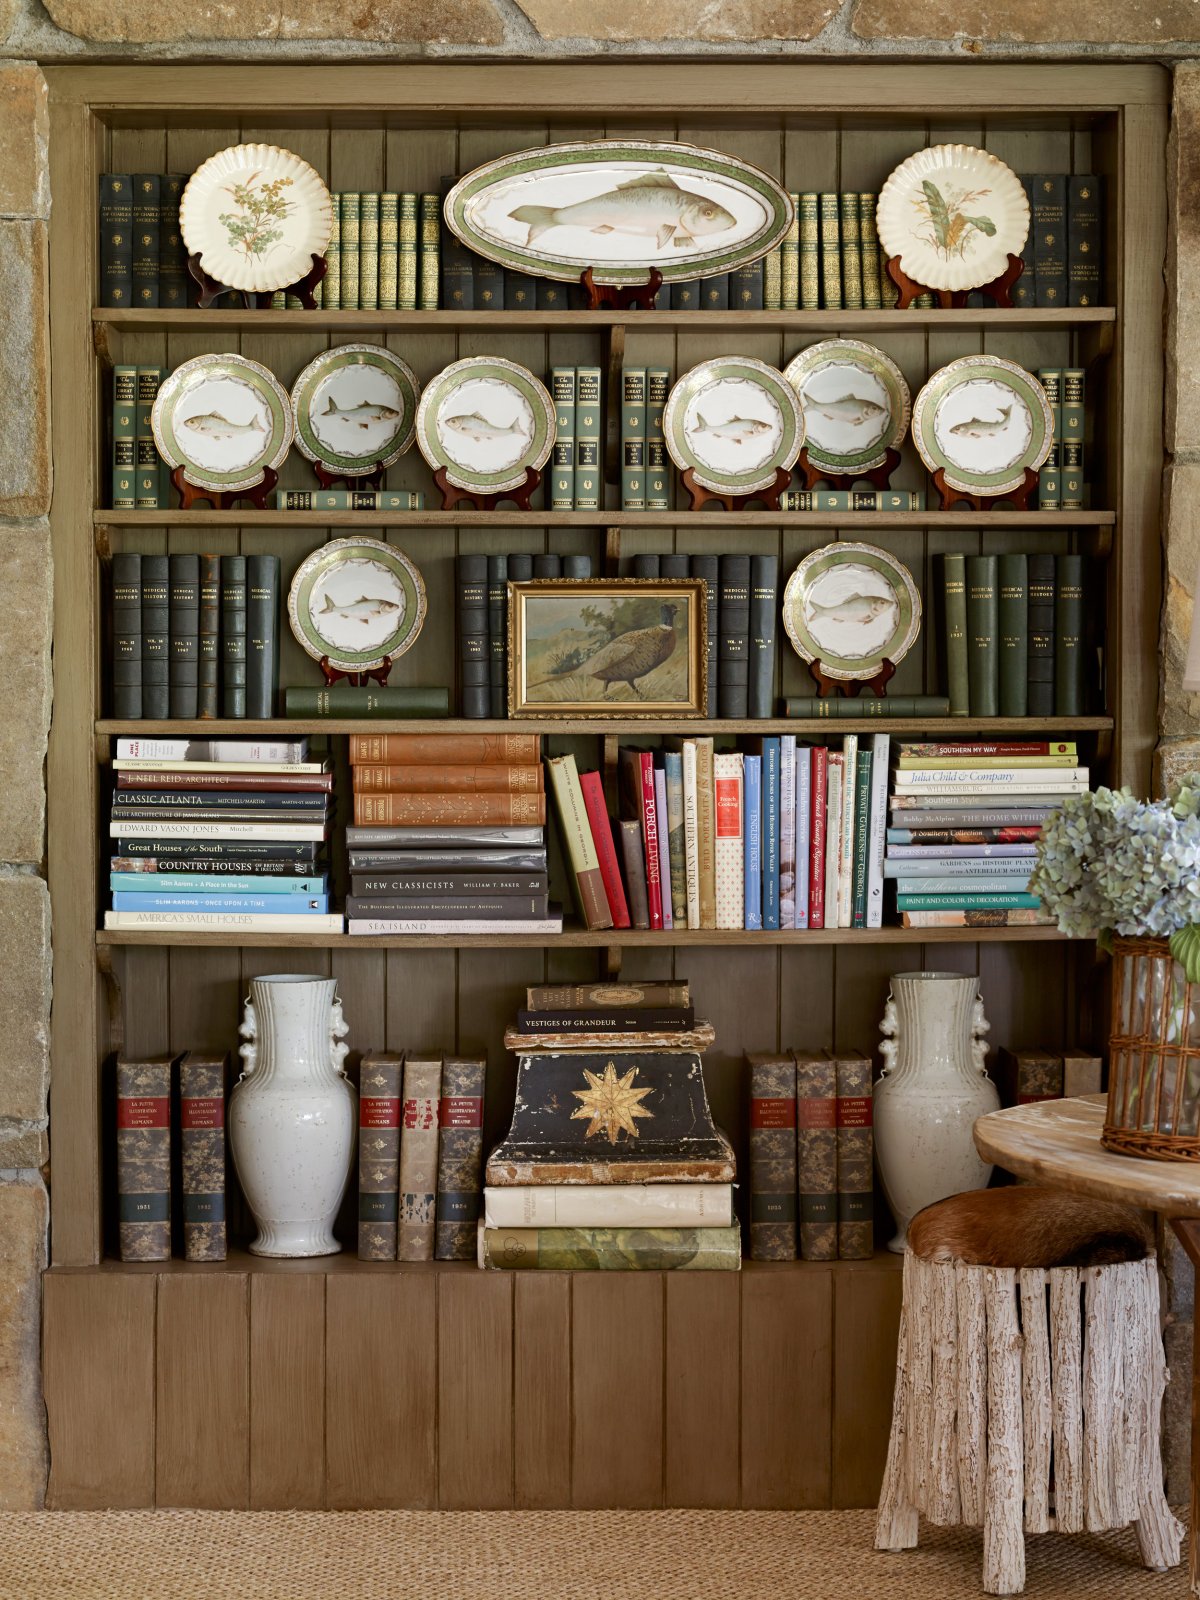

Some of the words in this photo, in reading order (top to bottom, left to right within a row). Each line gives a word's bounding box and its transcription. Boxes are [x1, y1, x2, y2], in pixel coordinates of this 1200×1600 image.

[701, 744, 709, 774] COLOR
[939, 746, 972, 755] SOUTHERN
[973, 746, 982, 754] MY
[983, 746, 997, 754] WAY
[800, 761, 809, 787] Charles
[910, 772, 931, 784] Julia
[932, 771, 957, 782] Child
[958, 771, 968, 781] &
[969, 771, 1014, 783] Company
[702, 779, 709, 789] IN
[926, 785, 983, 793] WILLIAMSBURG
[117, 794, 157, 804] CLASSIC
[159, 795, 203, 805] ATLANTA
[769, 795, 775, 803] OF
[800, 787, 809, 814] Faudree
[830, 770, 840, 821] Entertaining
[859, 784, 868, 815] PRIVATE
[924, 796, 959, 805] Southern
[960, 796, 979, 805] Style
[717, 801, 738, 809] Cooking
[815, 792, 824, 818] French
[563, 762, 571, 786] WHITE
[568, 788, 579, 822] COLUMNS
[576, 824, 582, 832] IN
[579, 833, 589, 867] GEORGIA
[645, 799, 657, 840] PORCH
[686, 795, 695, 850] SOUTHERN
[702, 794, 710, 844] PORTRAITS
[903, 816, 923, 824] Bobby
[925, 815, 955, 823] McAlpine
[962, 815, 980, 823] THE
[119, 824, 158, 833] EDWARD
[160, 825, 190, 833] VASON
[192, 825, 220, 835] JONES
[750, 814, 758, 845] ENGLISH
[800, 814, 808, 844] Interiors
[878, 814, 886, 834] STYLE
[813, 819, 823, 848] Country
[858, 816, 867, 853] GARDENS
[128, 843, 150, 852] Great
[152, 843, 182, 852] Houses
[184, 846, 190, 854] of
[199, 844, 223, 853] South
[648, 842, 659, 884] LIVING
[750, 847, 758, 873] HOUSE
[813, 847, 822, 883] Signature
[858, 853, 864, 862] OF
[159, 861, 209, 871] COUNTRY
[211, 862, 252, 872] HOUSES
[365, 882, 387, 890] NEW
[391, 882, 454, 890] CLASSICISTS
[687, 853, 696, 904] ANTIQUES
[857, 863, 866, 898] GEORGIA
[902, 884, 913, 893] the
[914, 879, 958, 892] Southern
[959, 884, 1007, 893] cosmopolitan
[942, 897, 965, 905] COLOR
[976, 896, 1019, 904] DECORATION
[135, 913, 184, 924] AMERICA'S
[185, 914, 217, 925] SMALL
[217, 914, 253, 925] HOUSES
[368, 922, 386, 931] SEA
[389, 921, 428, 931] ISLAND
[573, 1019, 617, 1027] GRANDEUR
